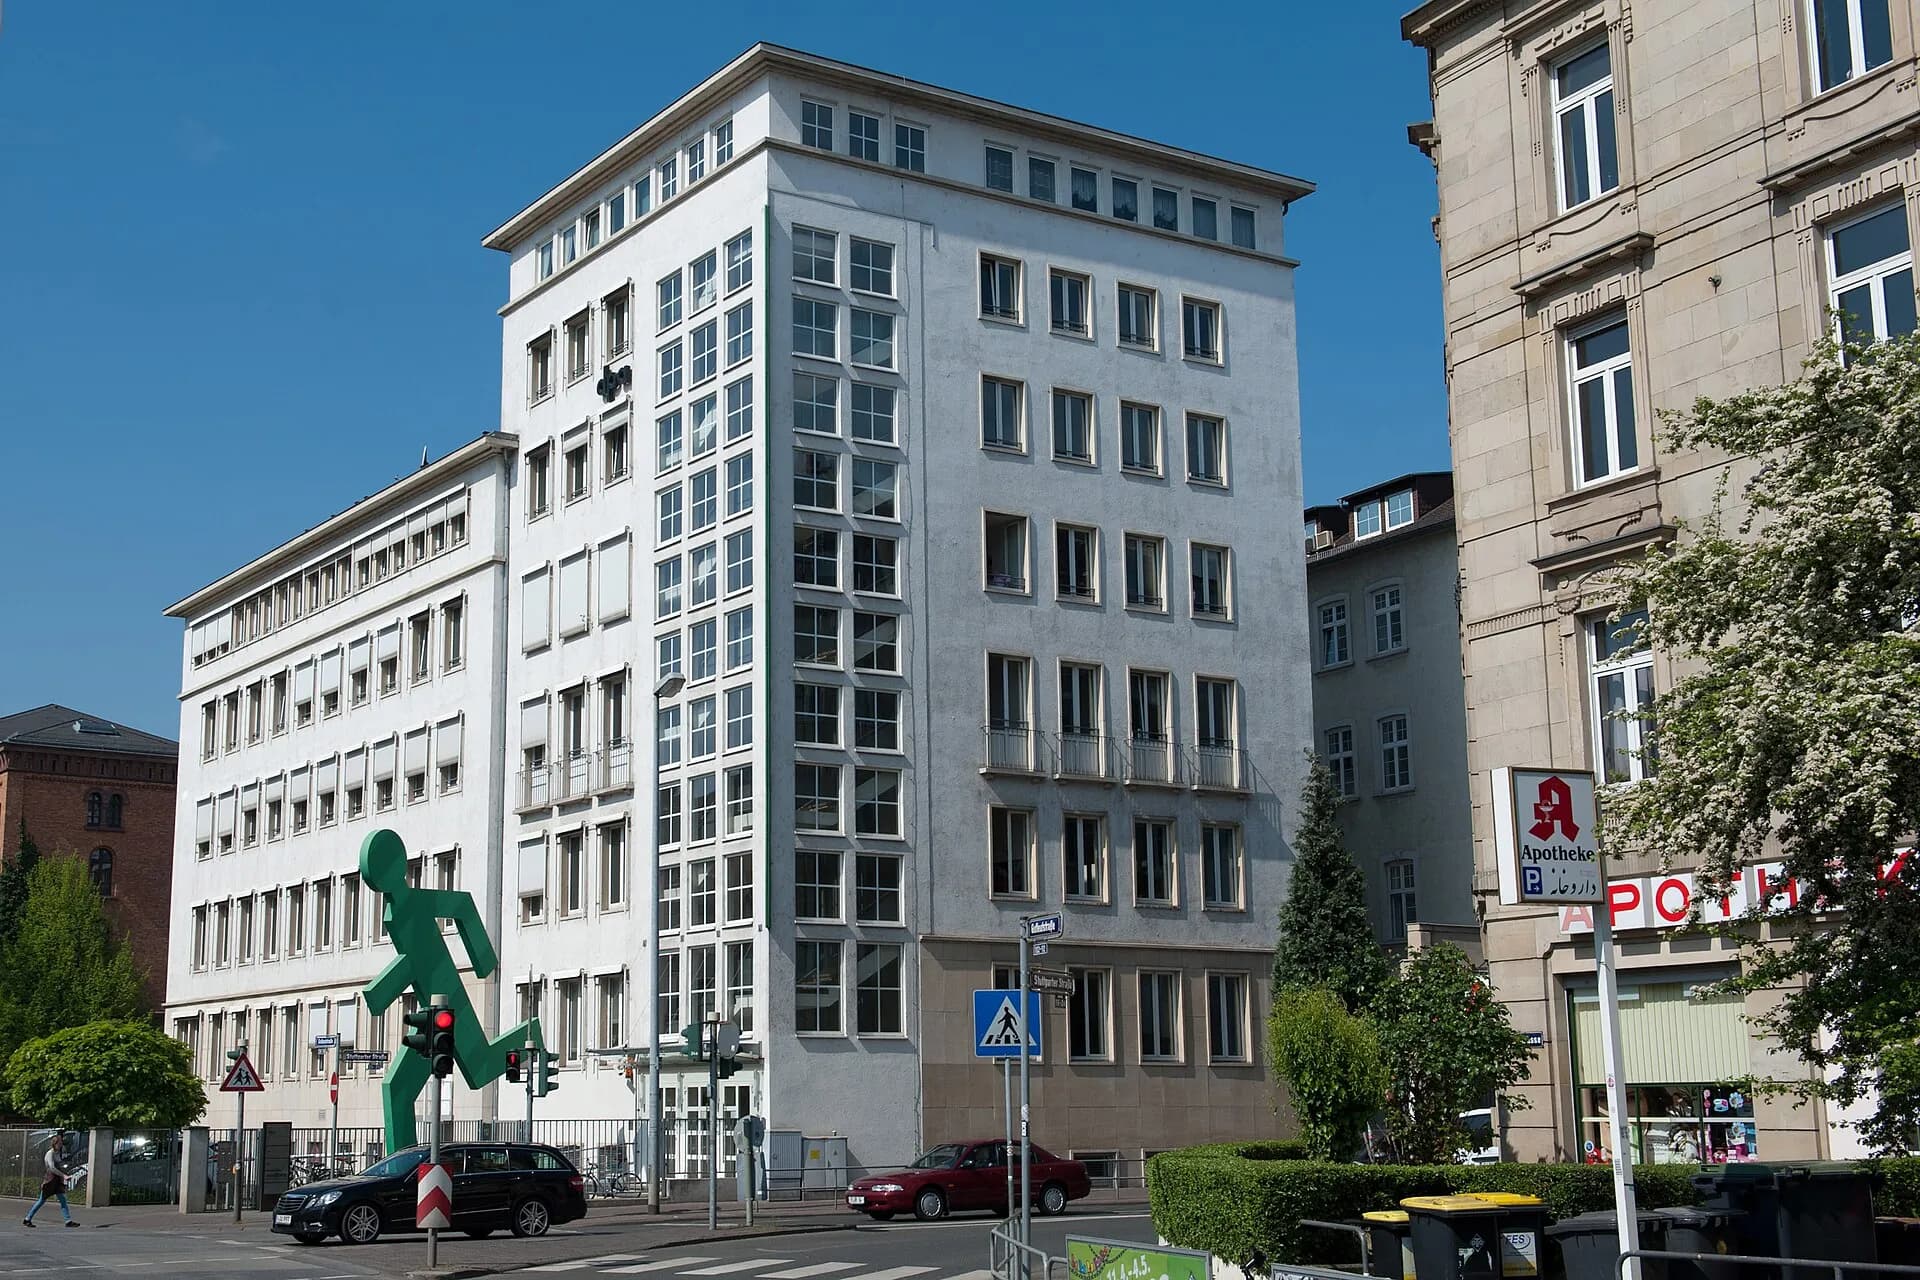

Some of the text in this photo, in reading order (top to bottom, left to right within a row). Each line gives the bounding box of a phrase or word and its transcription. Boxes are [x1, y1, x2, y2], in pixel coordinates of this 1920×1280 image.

[1521, 844, 1596, 864] Apotheke
[1525, 869, 1541, 892] P
[1561, 850, 1917, 932] APOTHK
[1505, 1234, 1525, 1244] FES
[1106, 1254, 1151, 1280] 114.-4.5.
